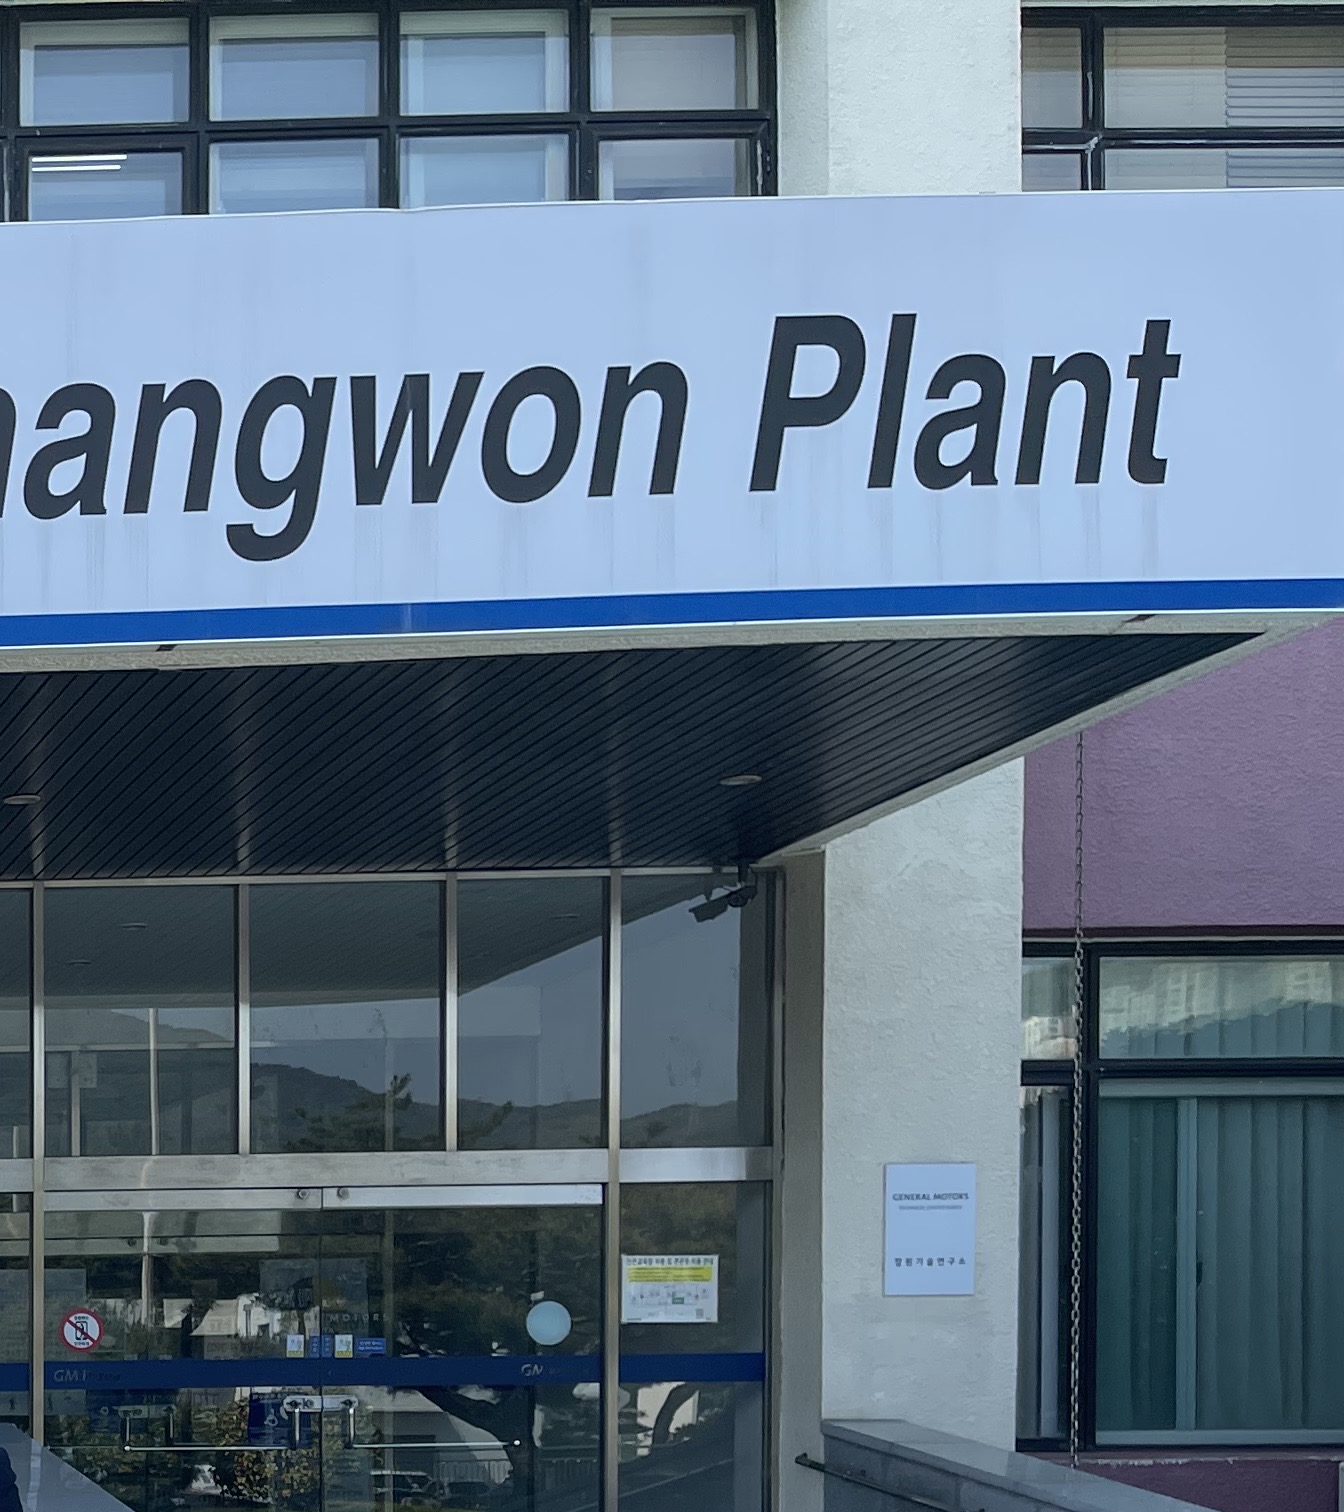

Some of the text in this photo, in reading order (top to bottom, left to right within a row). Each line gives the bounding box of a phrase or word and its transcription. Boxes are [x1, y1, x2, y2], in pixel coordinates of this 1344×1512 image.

[748, 312, 1182, 491] Plant
[892, 1192, 969, 1201] GENERAL MOTORS
